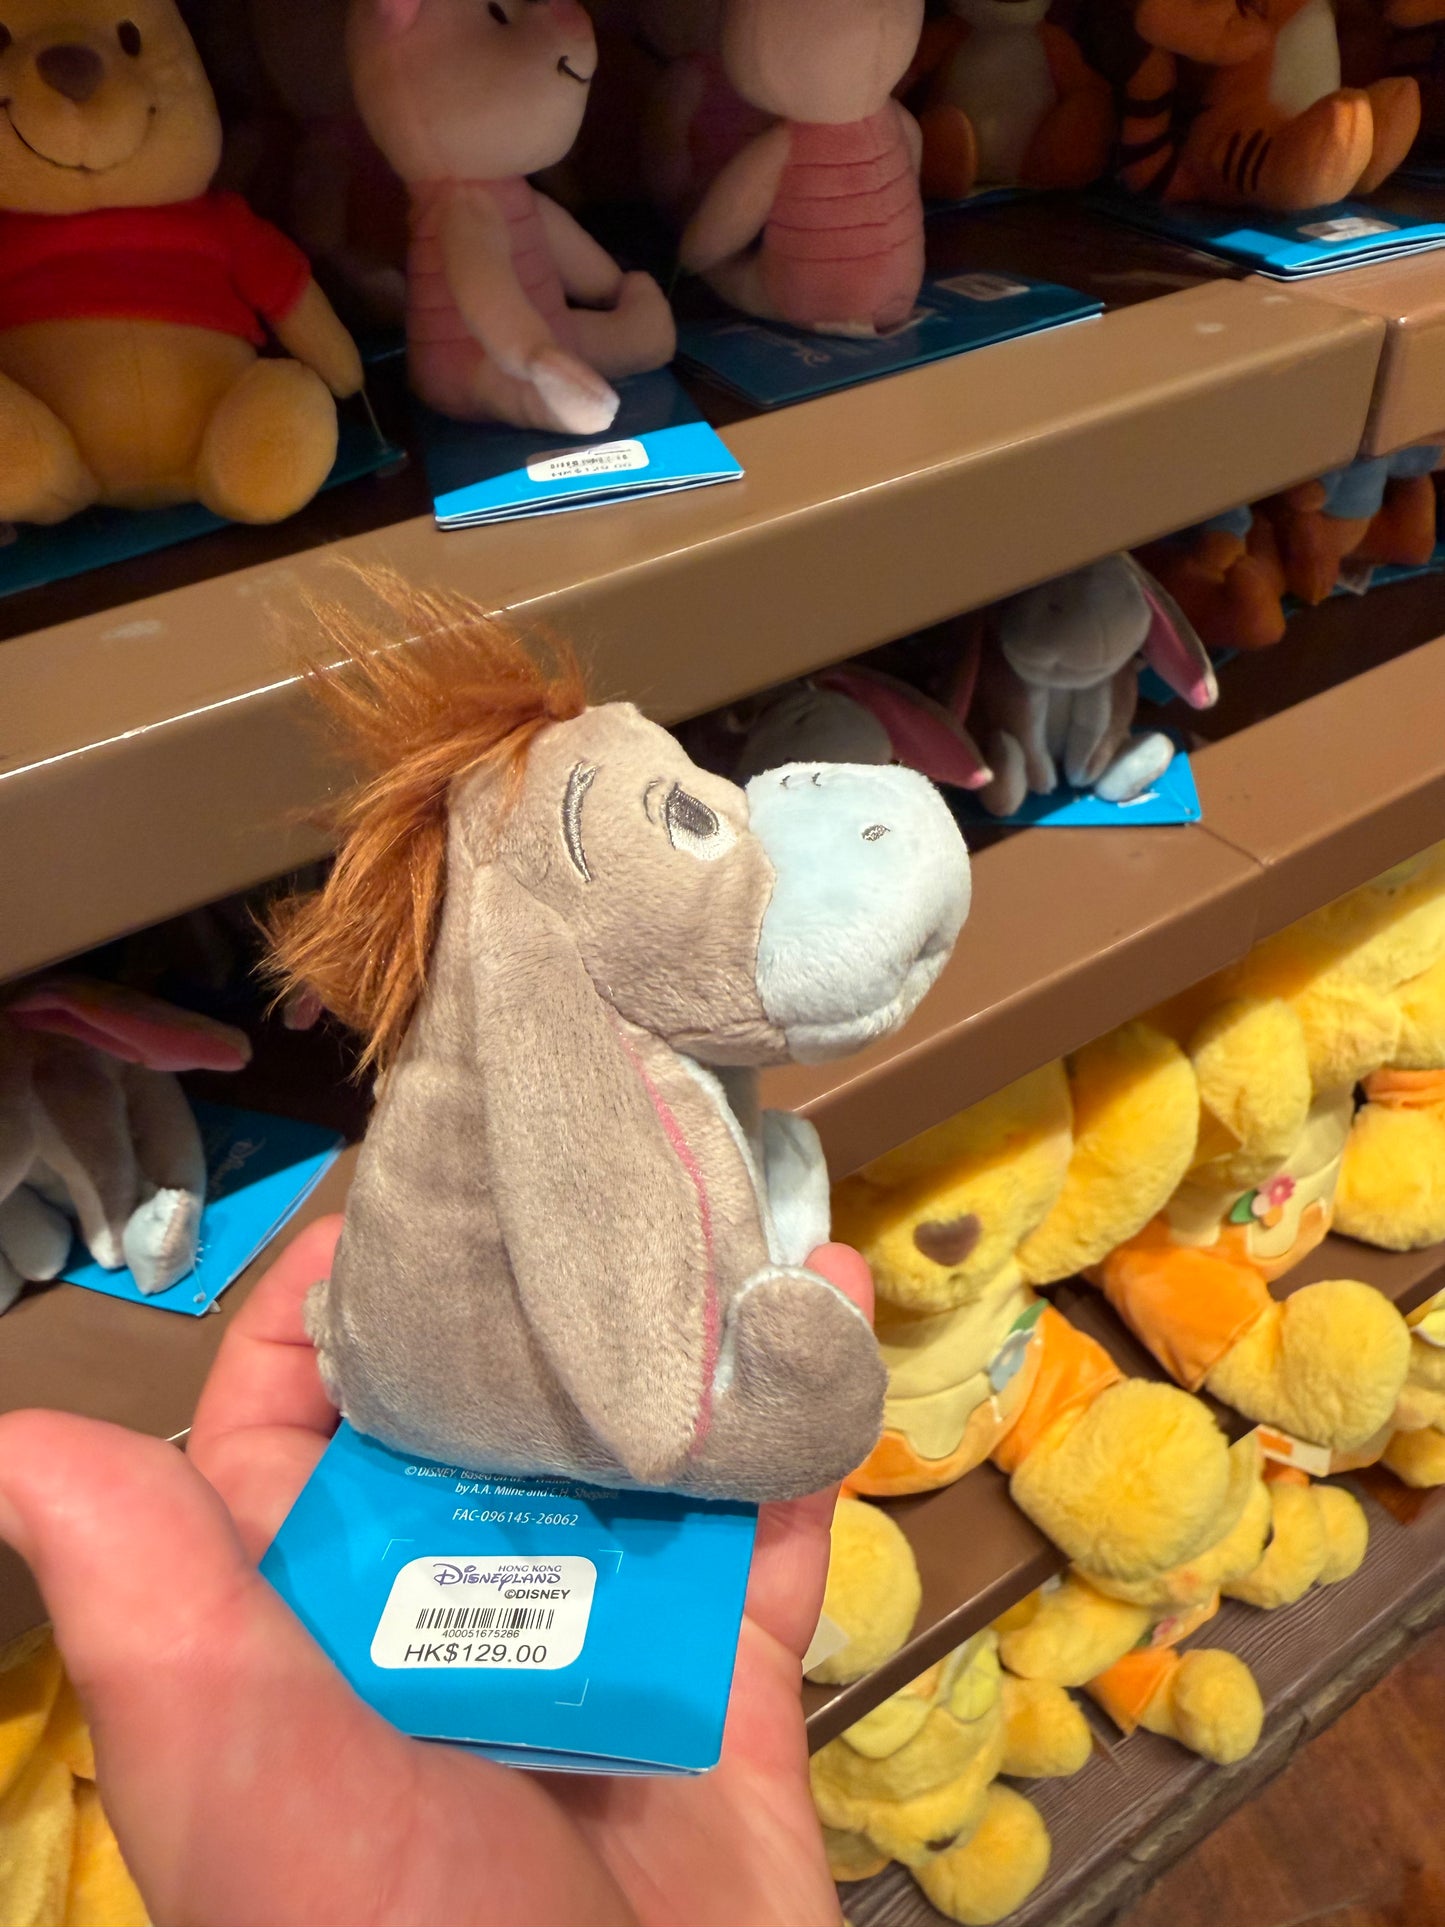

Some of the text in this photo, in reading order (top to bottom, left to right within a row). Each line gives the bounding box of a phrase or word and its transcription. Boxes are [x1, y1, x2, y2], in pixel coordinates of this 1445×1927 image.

[455, 1482, 469, 1495] by
[470, 1483, 492, 1495] A.A.
[452, 1508, 579, 1526] FAC-096145-26062
[498, 1564, 562, 1573] HONG KONG
[442, 1629, 520, 1638] 400051675286
[404, 1642, 547, 1664] HK$129.00
